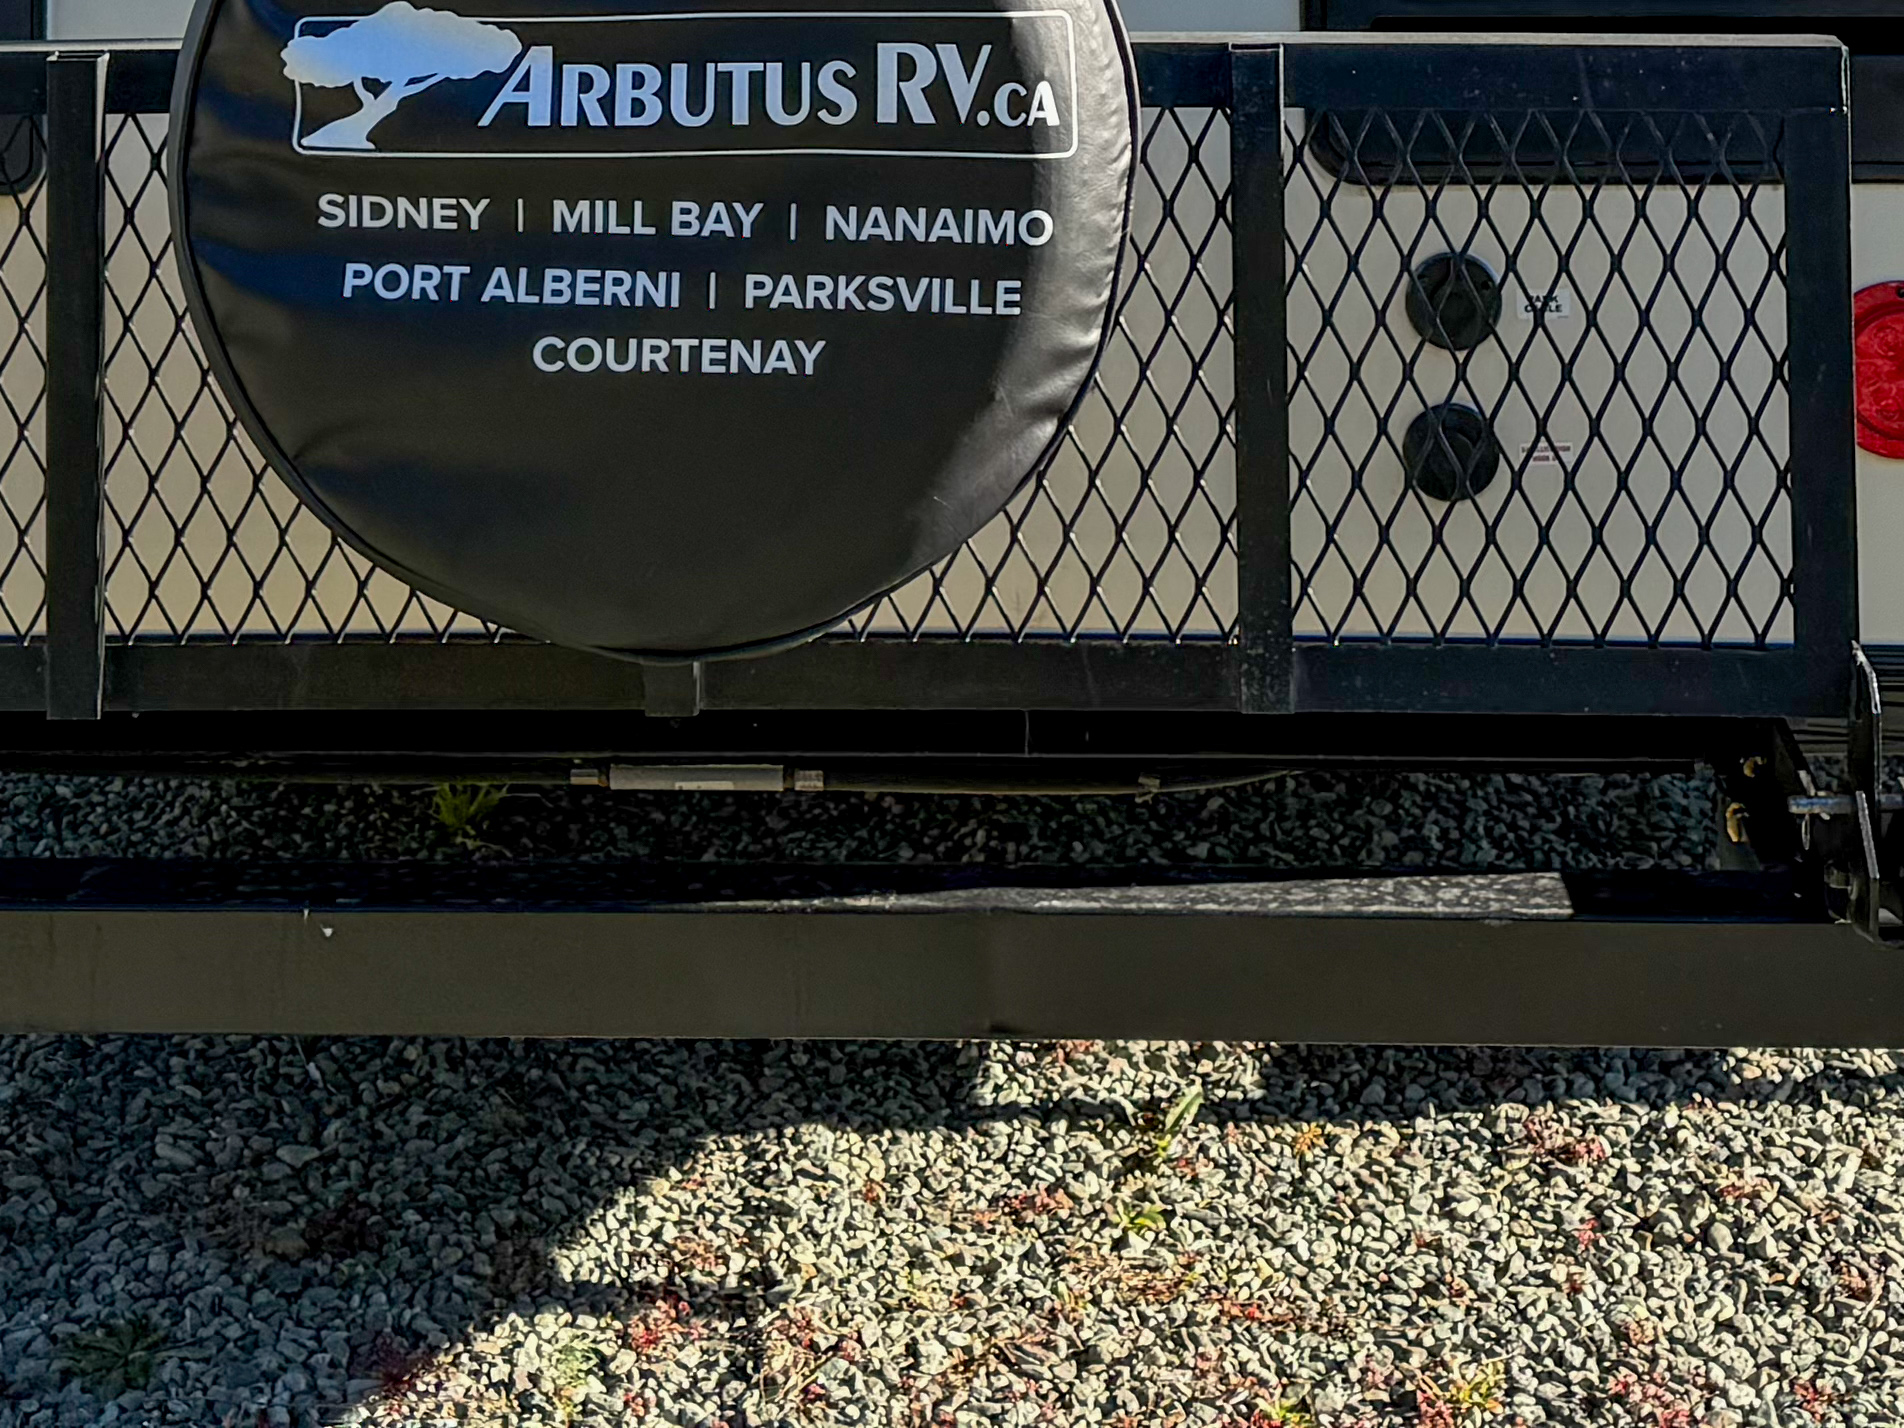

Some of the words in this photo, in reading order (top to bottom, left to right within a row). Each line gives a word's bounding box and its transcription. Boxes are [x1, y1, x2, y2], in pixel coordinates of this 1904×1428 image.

[478, 44, 857, 127] ARBUTUS
[317, 193, 492, 232] SIDNEY
[552, 199, 656, 236] MILL
[671, 200, 765, 238] BAY
[825, 204, 1055, 247] NANAIMO
[342, 262, 471, 302] PORT
[480, 266, 681, 309] ALBERNI
[744, 273, 1022, 315] PARKSVILLE
[531, 335, 826, 376] COURTENAY
